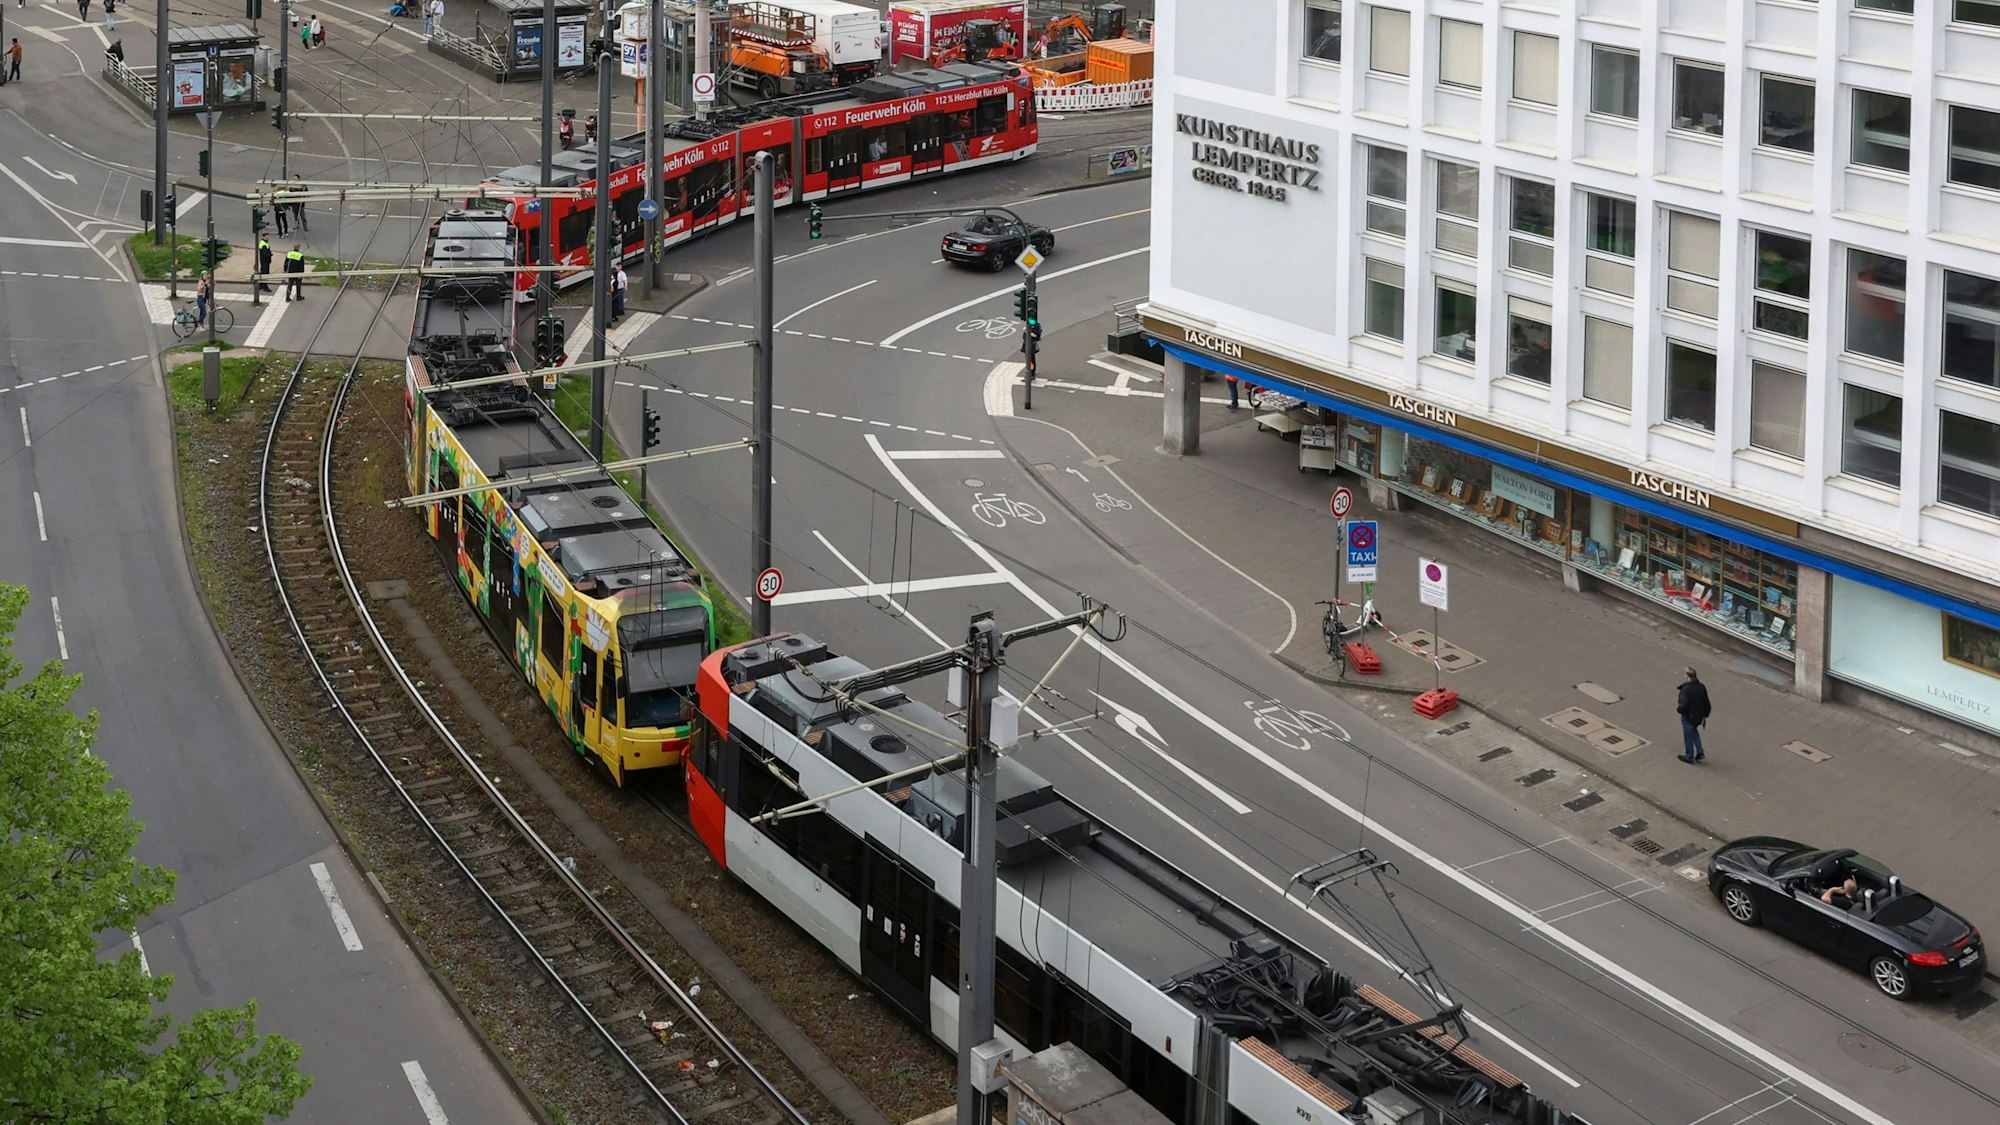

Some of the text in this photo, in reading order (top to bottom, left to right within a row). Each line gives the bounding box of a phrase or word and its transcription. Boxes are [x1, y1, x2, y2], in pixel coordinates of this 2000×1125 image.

[516, 36, 541, 44] Freude
[668, 28, 674, 38] U
[209, 46, 217, 55] U
[935, 96, 947, 105] 112
[954, 90, 982, 102] Herzblut
[983, 88, 993, 97] für
[993, 85, 1009, 95] Köln
[823, 99, 926, 127] 112 Feuerwehr Köln
[1176, 113, 1319, 164] KUNSTHAUS
[685, 147, 704, 165] Köln
[718, 140, 729, 152] 112
[1192, 141, 1319, 191] LEMPERTZ
[1246, 180, 1286, 202] 1845
[1183, 327, 1242, 358] TASCHEN
[1387, 392, 1456, 427] TASCHEN
[1494, 471, 1528, 492] WALTON
[1529, 486, 1553, 502] FORD
[1628, 468, 1710, 508] TASCHEN
[1335, 495, 1348, 510] 30
[762, 576, 778, 592] 30
[1927, 684, 1991, 715] LEMPERTZ
[1296, 1106, 1312, 1121] KVB
